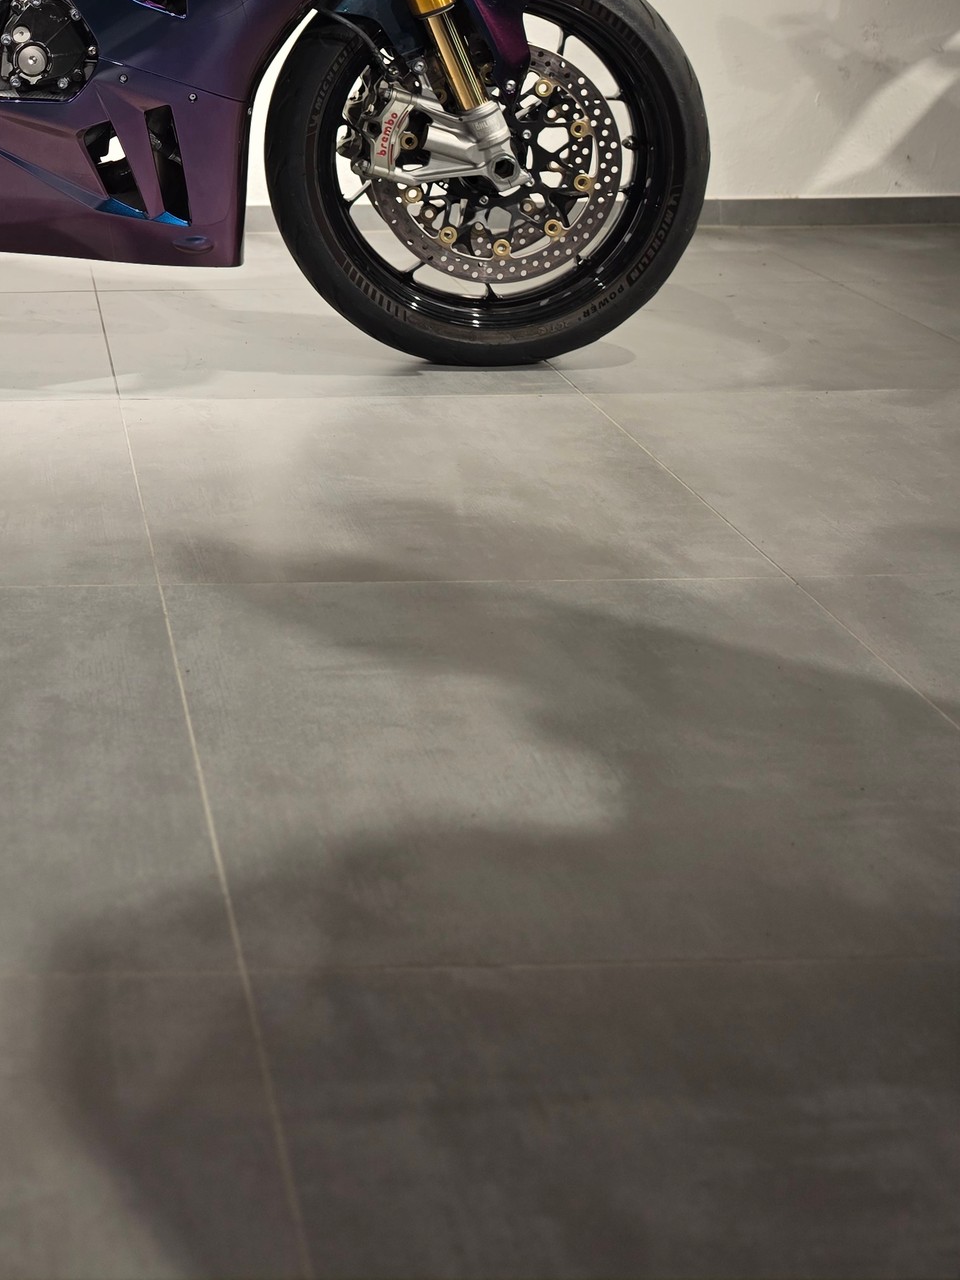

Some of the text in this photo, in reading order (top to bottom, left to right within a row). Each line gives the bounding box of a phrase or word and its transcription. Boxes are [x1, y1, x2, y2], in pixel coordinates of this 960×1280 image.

[376, 112, 398, 157] brembo
[630, 208, 675, 280] MICHELIN
[583, 283, 625, 318] POWER
